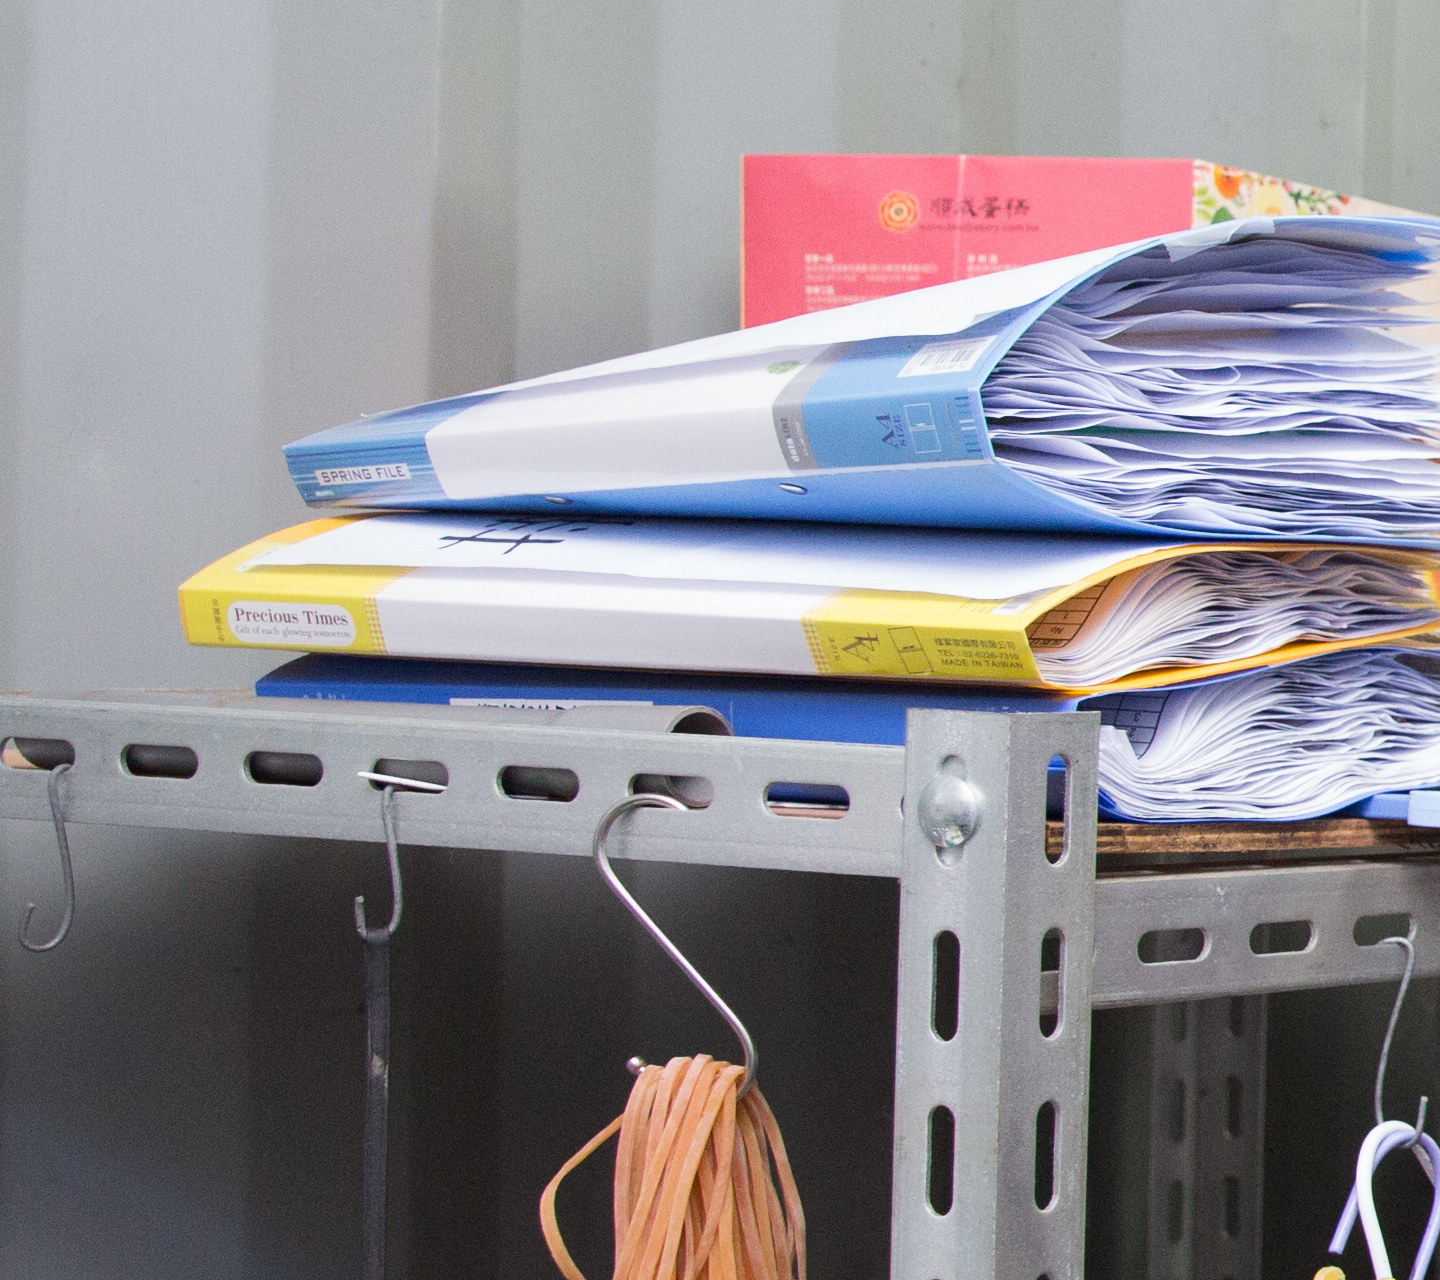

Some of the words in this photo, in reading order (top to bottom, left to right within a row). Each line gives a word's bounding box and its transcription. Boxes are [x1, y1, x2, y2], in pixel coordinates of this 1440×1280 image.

[876, 414, 900, 449] A4
[321, 468, 372, 483] SPRING
[375, 465, 406, 480] FILE
[234, 607, 299, 624] Precious
[302, 610, 349, 626] Times
[842, 632, 880, 663] A4
[941, 658, 968, 667] MADE
[984, 660, 1023, 670] TAIWAN
